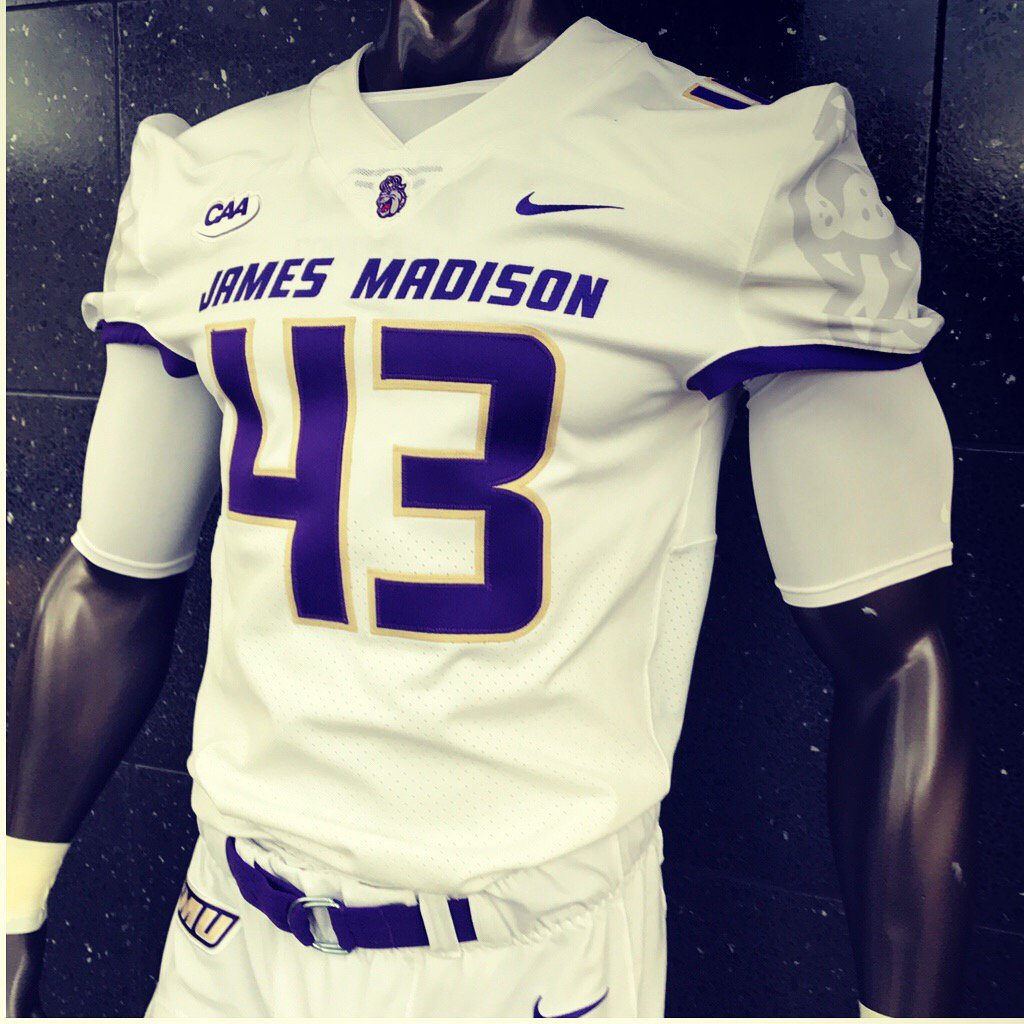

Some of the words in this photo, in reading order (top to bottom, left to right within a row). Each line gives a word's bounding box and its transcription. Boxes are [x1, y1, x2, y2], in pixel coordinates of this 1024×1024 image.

[204, 197, 250, 228] CAA
[198, 257, 335, 312] JAMES
[351, 258, 610, 318] MADISON
[205, 316, 567, 644] 43
